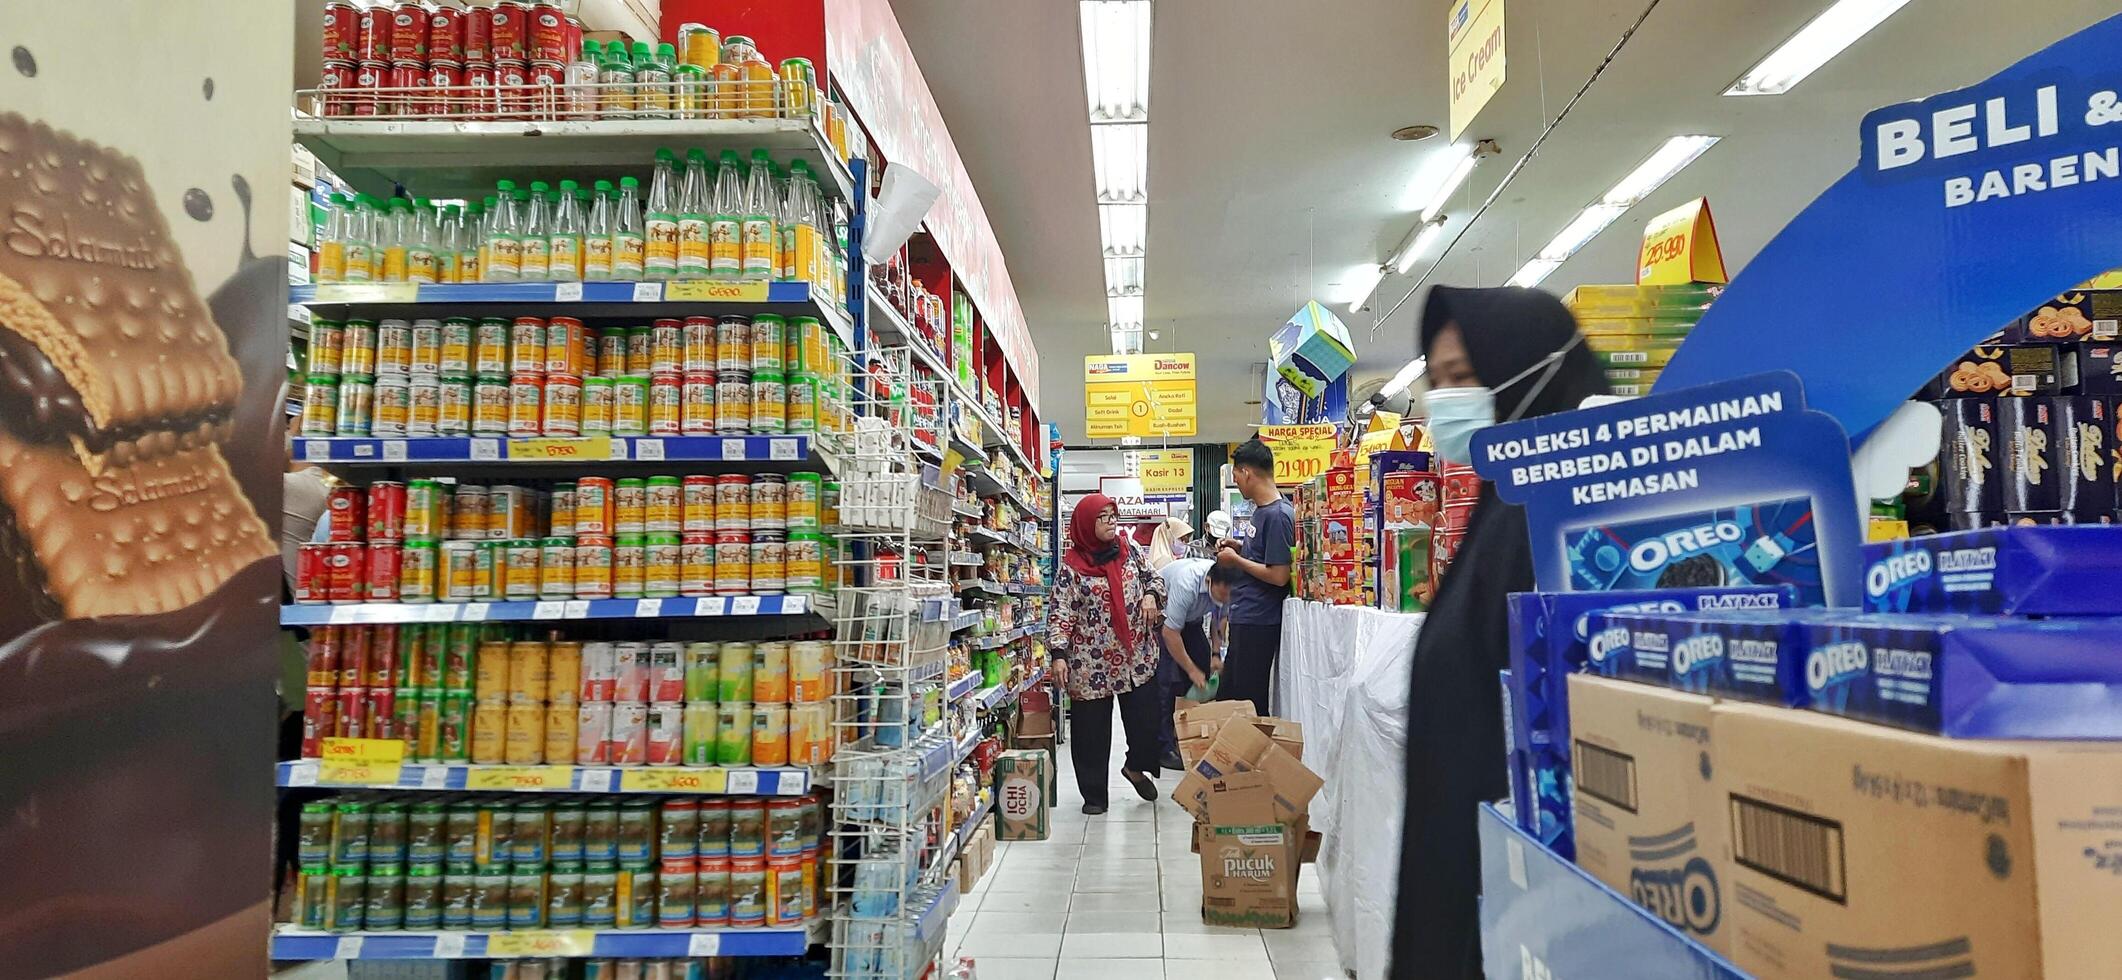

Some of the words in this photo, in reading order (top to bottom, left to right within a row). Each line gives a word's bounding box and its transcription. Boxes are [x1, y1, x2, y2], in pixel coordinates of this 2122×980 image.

[1453, 72, 1466, 104] Ice
[1468, 25, 1501, 83] Cream
[1877, 85, 2059, 171] BELI
[1944, 147, 2120, 208] BAREN
[1154, 360, 1190, 370] Dancow
[1268, 427, 1297, 437] HARGA
[1300, 426, 1333, 437] SPECIAL
[1487, 429, 1590, 462] KOLEKSI
[1596, 424, 1612, 443] 4
[1618, 391, 1783, 441] PERMAINAN
[1145, 468, 1169, 477] Kasir
[1174, 468, 1185, 477] 13
[1512, 455, 1629, 486] BERBEDA
[1632, 447, 1659, 467] DI
[1665, 427, 1762, 462] DALAM
[1572, 469, 1699, 505] KEMASAN
[1630, 522, 1742, 573] OREO
[1868, 551, 1931, 597] OREO
[1589, 628, 1630, 662] OREO
[1673, 635, 1723, 675] OREO
[1807, 643, 1868, 689] OREO
[1007, 786, 1018, 814] ICHI
[1018, 785, 1027, 815] OCHA
[1224, 854, 1275, 878] pucuk
[1233, 870, 1271, 881] HARUM
